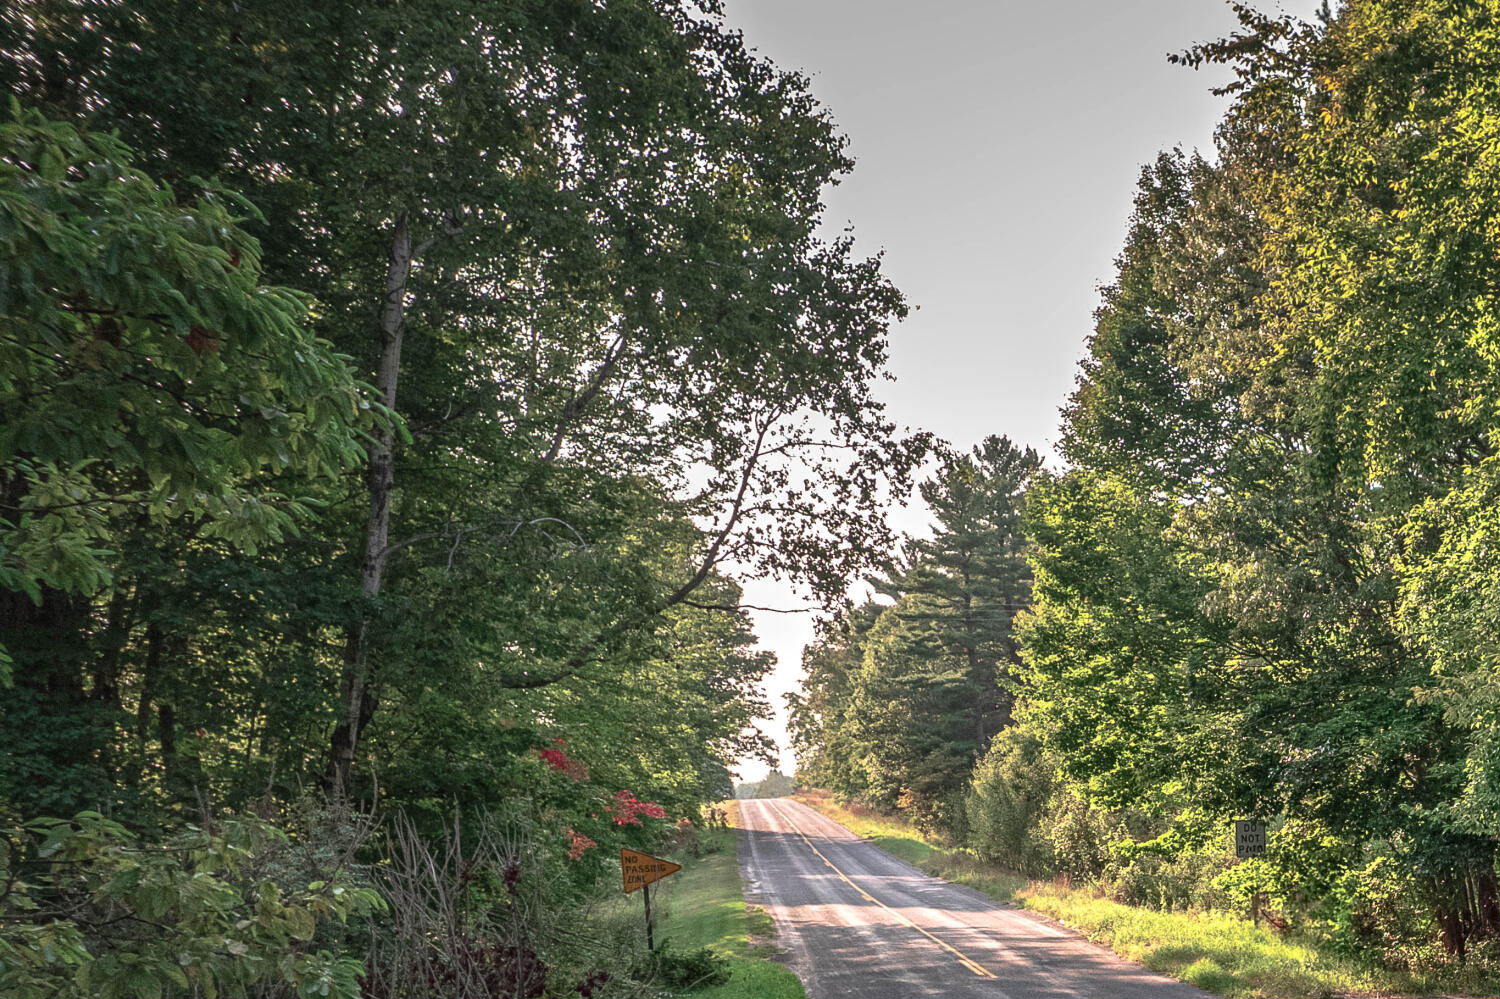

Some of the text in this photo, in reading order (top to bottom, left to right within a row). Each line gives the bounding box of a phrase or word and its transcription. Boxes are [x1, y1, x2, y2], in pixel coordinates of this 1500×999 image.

[1244, 824, 1257, 832] DO
[1241, 834, 1259, 843] NOT
[626, 864, 666, 874] PASSING
